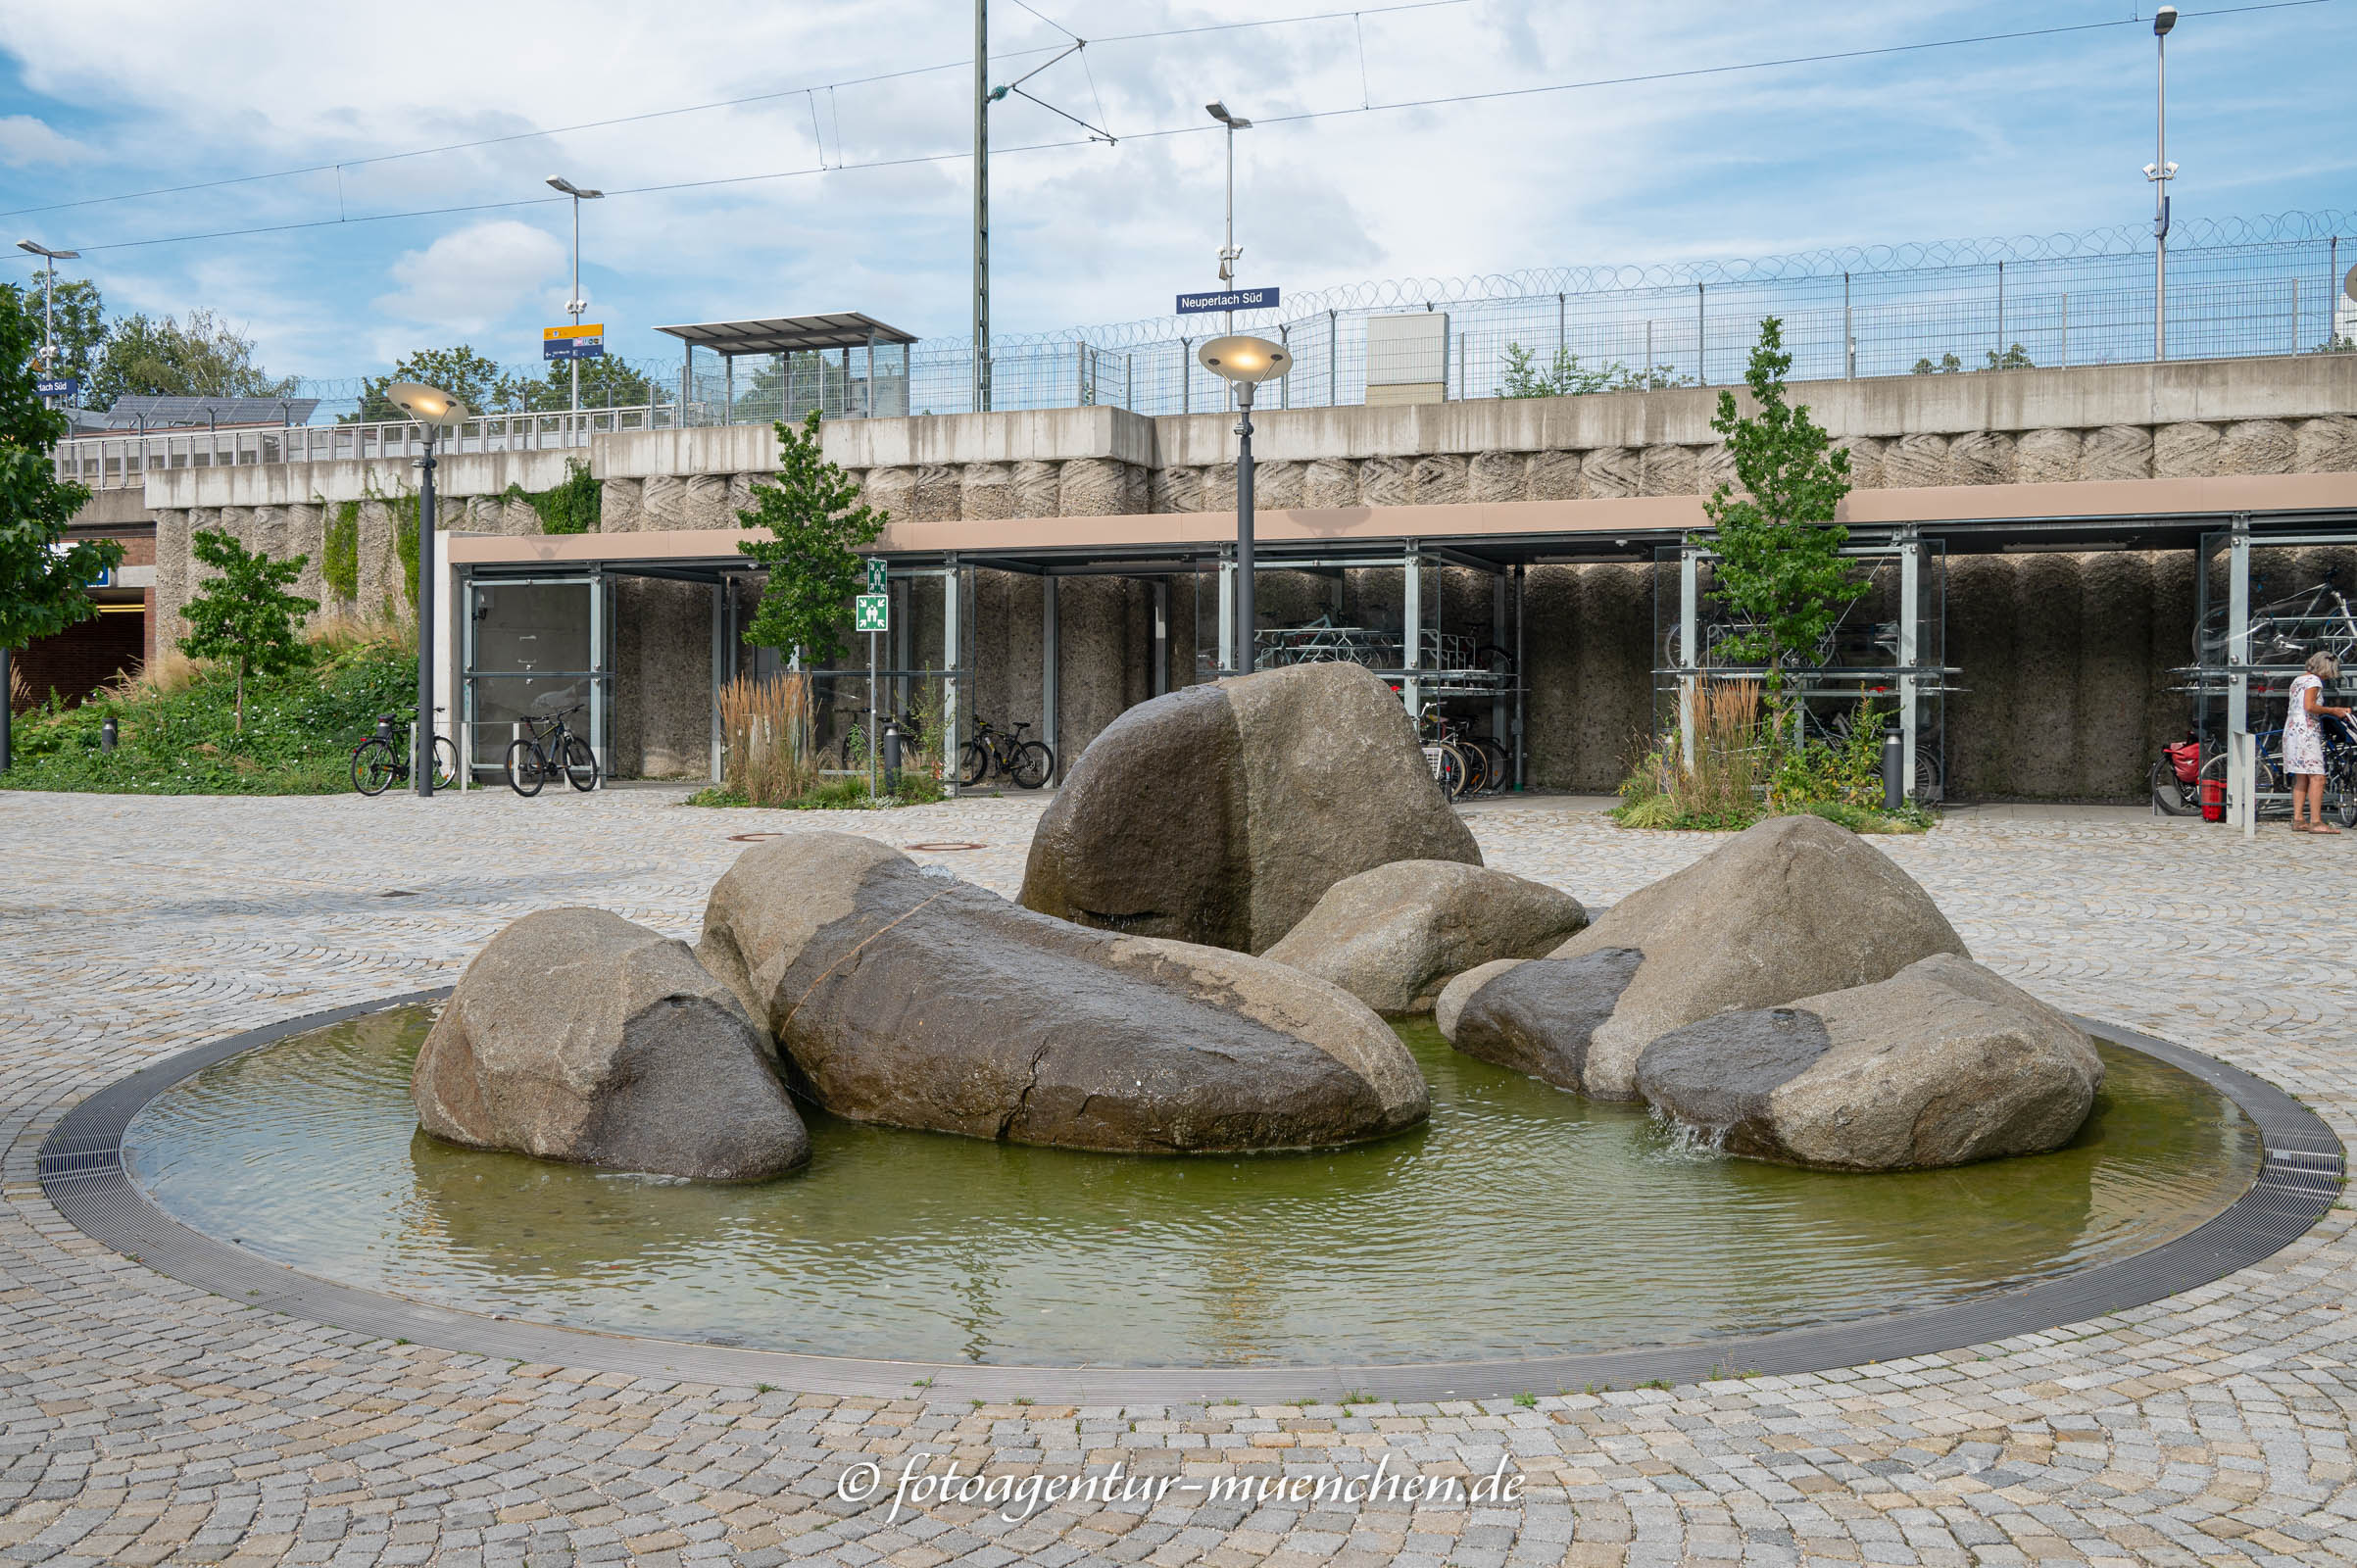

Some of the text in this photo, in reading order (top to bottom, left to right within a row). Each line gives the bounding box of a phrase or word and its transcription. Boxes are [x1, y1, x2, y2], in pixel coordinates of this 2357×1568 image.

[1181, 292, 1263, 309] Neuperlach Süd
[54, 381, 67, 390] Süd
